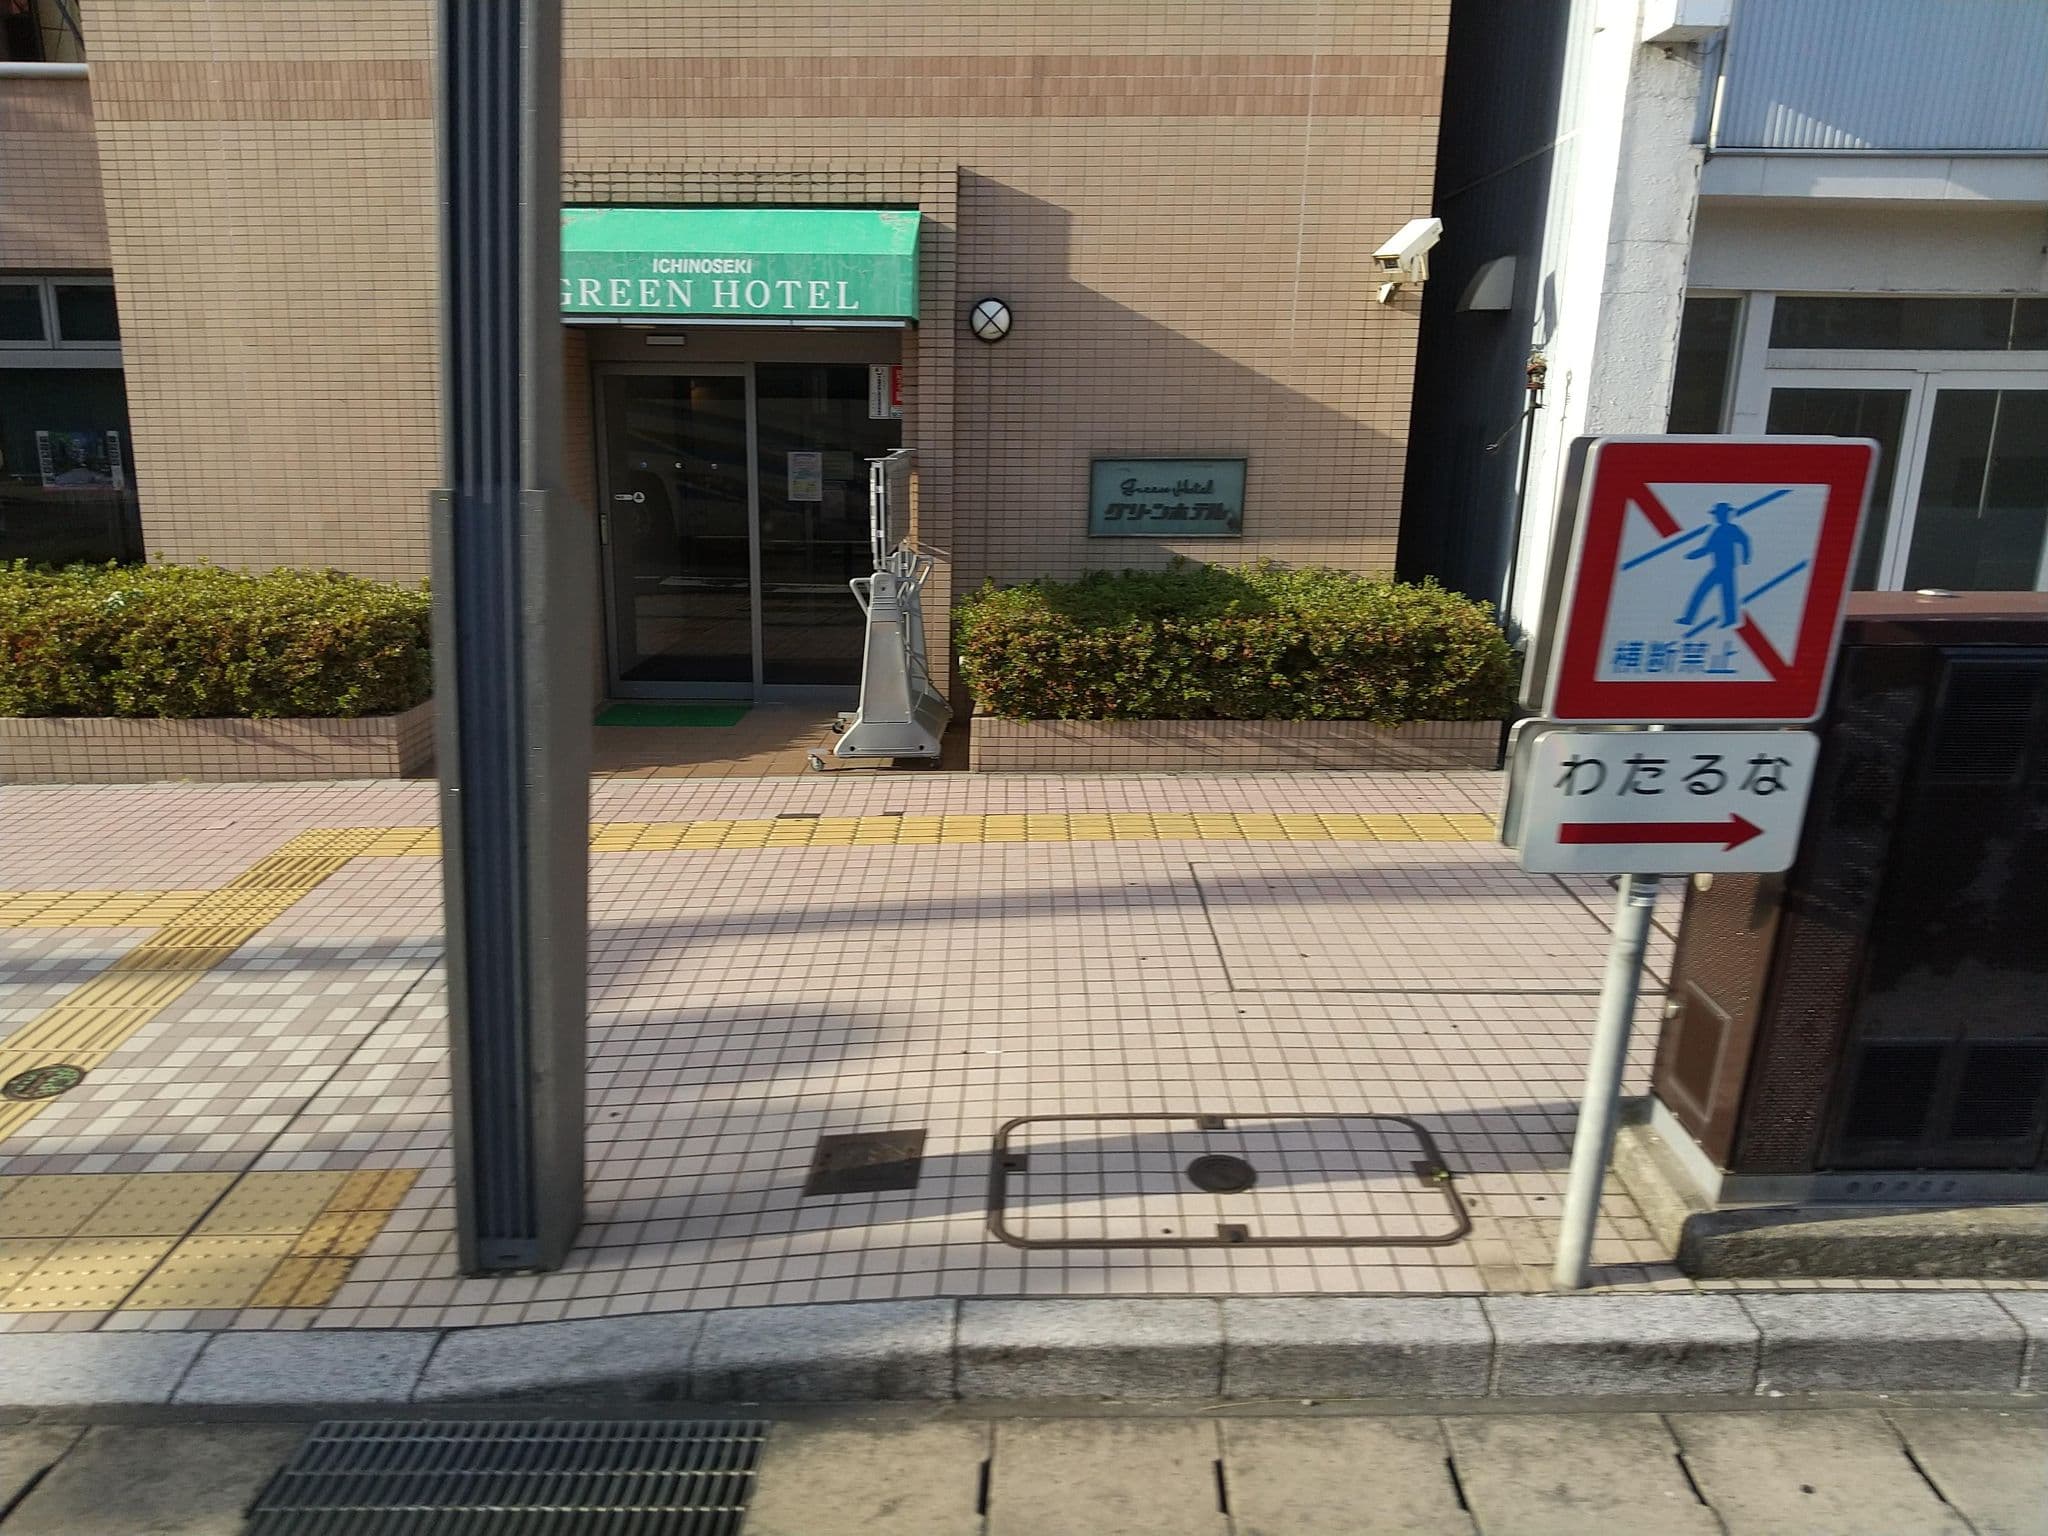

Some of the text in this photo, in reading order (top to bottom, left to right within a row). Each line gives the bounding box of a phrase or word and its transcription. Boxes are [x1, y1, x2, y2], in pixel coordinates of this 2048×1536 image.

[652, 257, 753, 274] ICHINOSEKI
[712, 280, 860, 310] HOTEL
[1120, 478, 1214, 497] Green Hotel
[1104, 503, 1232, 521] グリーンホテル
[1611, 640, 1740, 674] 横断禁止
[1554, 752, 1793, 797] わたるな
